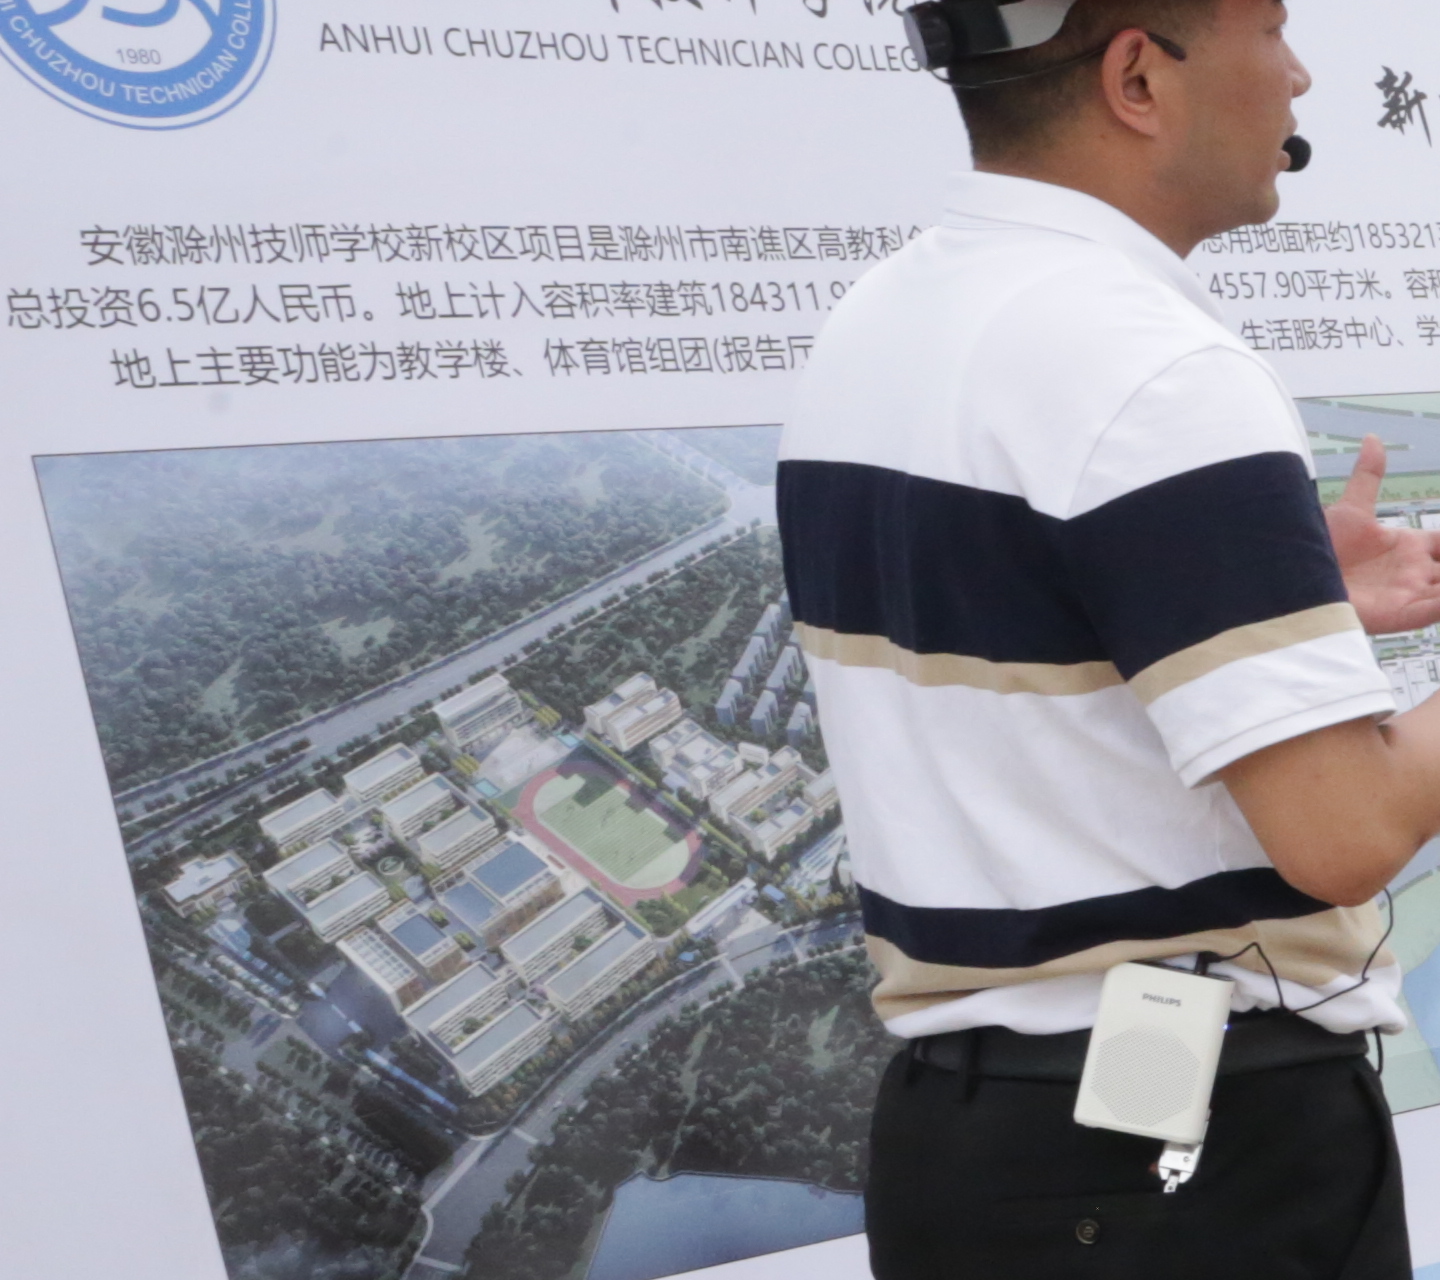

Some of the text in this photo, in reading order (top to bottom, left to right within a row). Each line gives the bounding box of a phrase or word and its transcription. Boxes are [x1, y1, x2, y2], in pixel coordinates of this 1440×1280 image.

[9, 15, 116, 98] CHUZHOU
[120, 50, 237, 105] TECHNICIAN
[115, 47, 162, 65] 1980
[319, 22, 433, 56] ANHUI
[443, 26, 610, 64] CHUZHOU
[617, 34, 804, 70] TECHNICIAN
[1142, 992, 1182, 1008] PHILIPS
